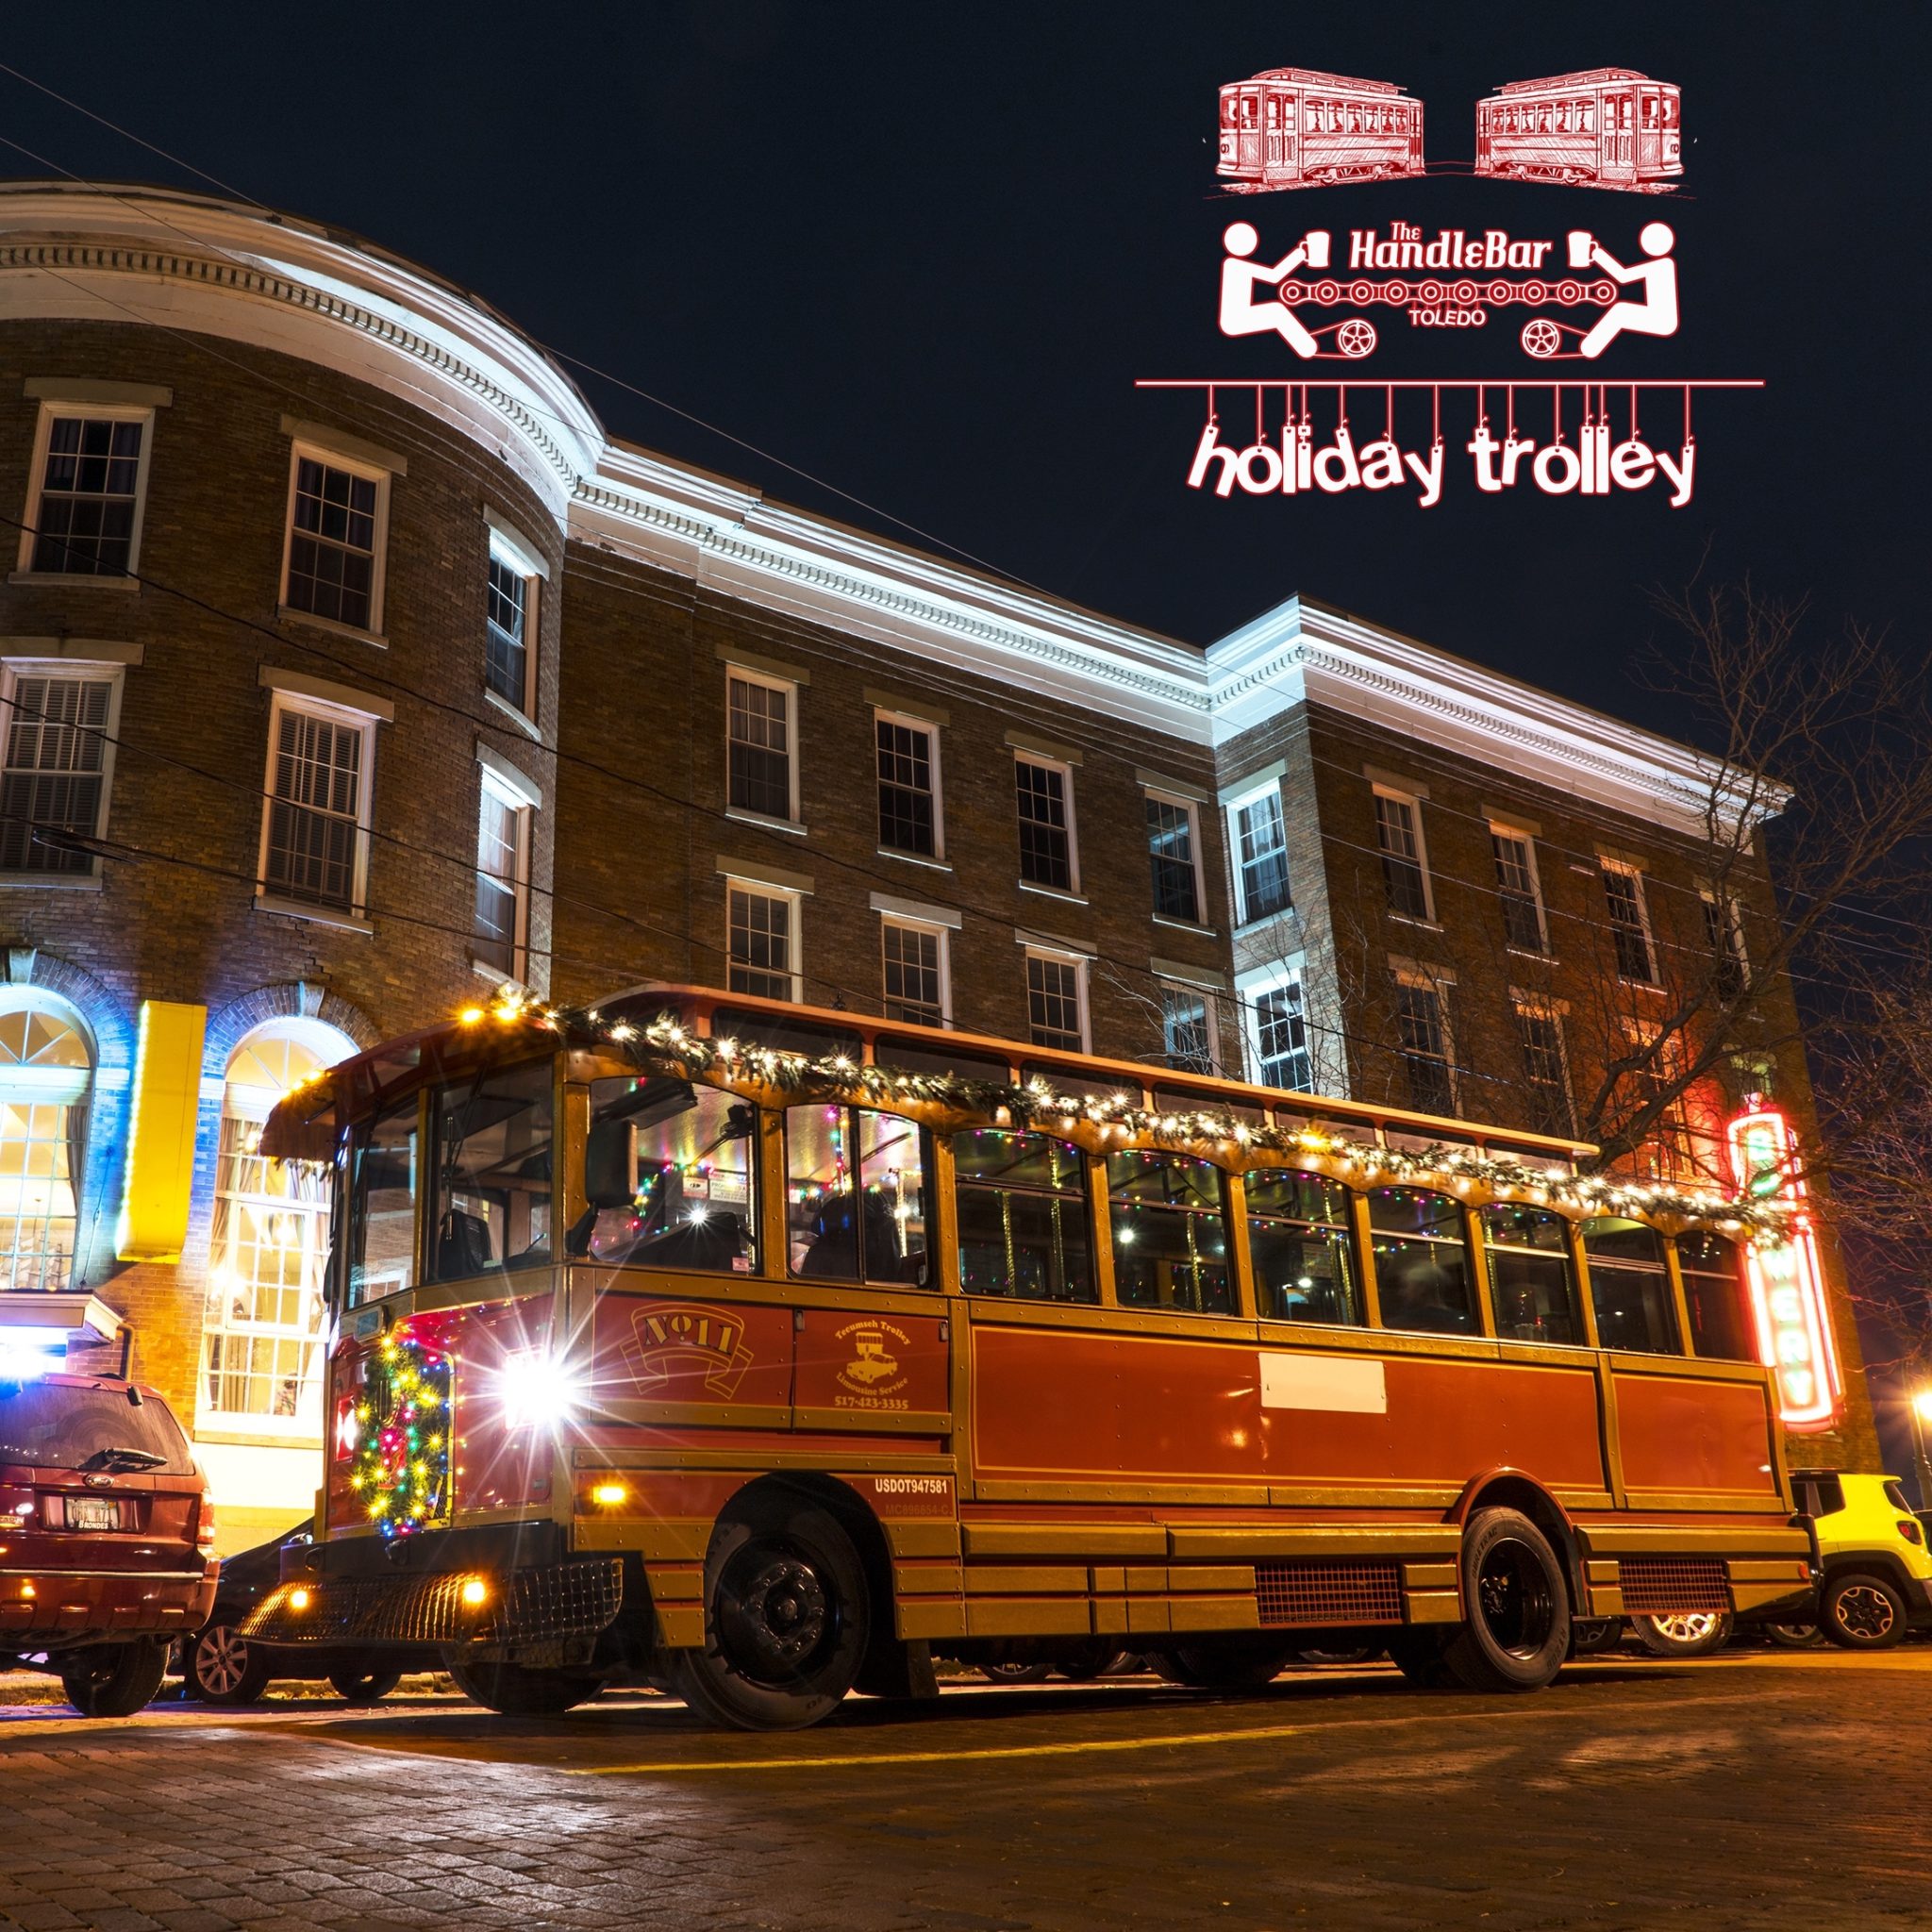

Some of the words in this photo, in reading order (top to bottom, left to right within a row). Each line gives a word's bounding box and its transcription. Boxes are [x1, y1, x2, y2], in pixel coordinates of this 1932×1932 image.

[1745, 1127, 1813, 1406] BWERY
[835, 1320, 878, 1340] Tecumseh
[880, 1321, 911, 1345] Trolley
[836, 1372, 877, 1396] Limousine
[878, 1377, 908, 1396] Service
[874, 1478, 947, 1494] USDOT947581
